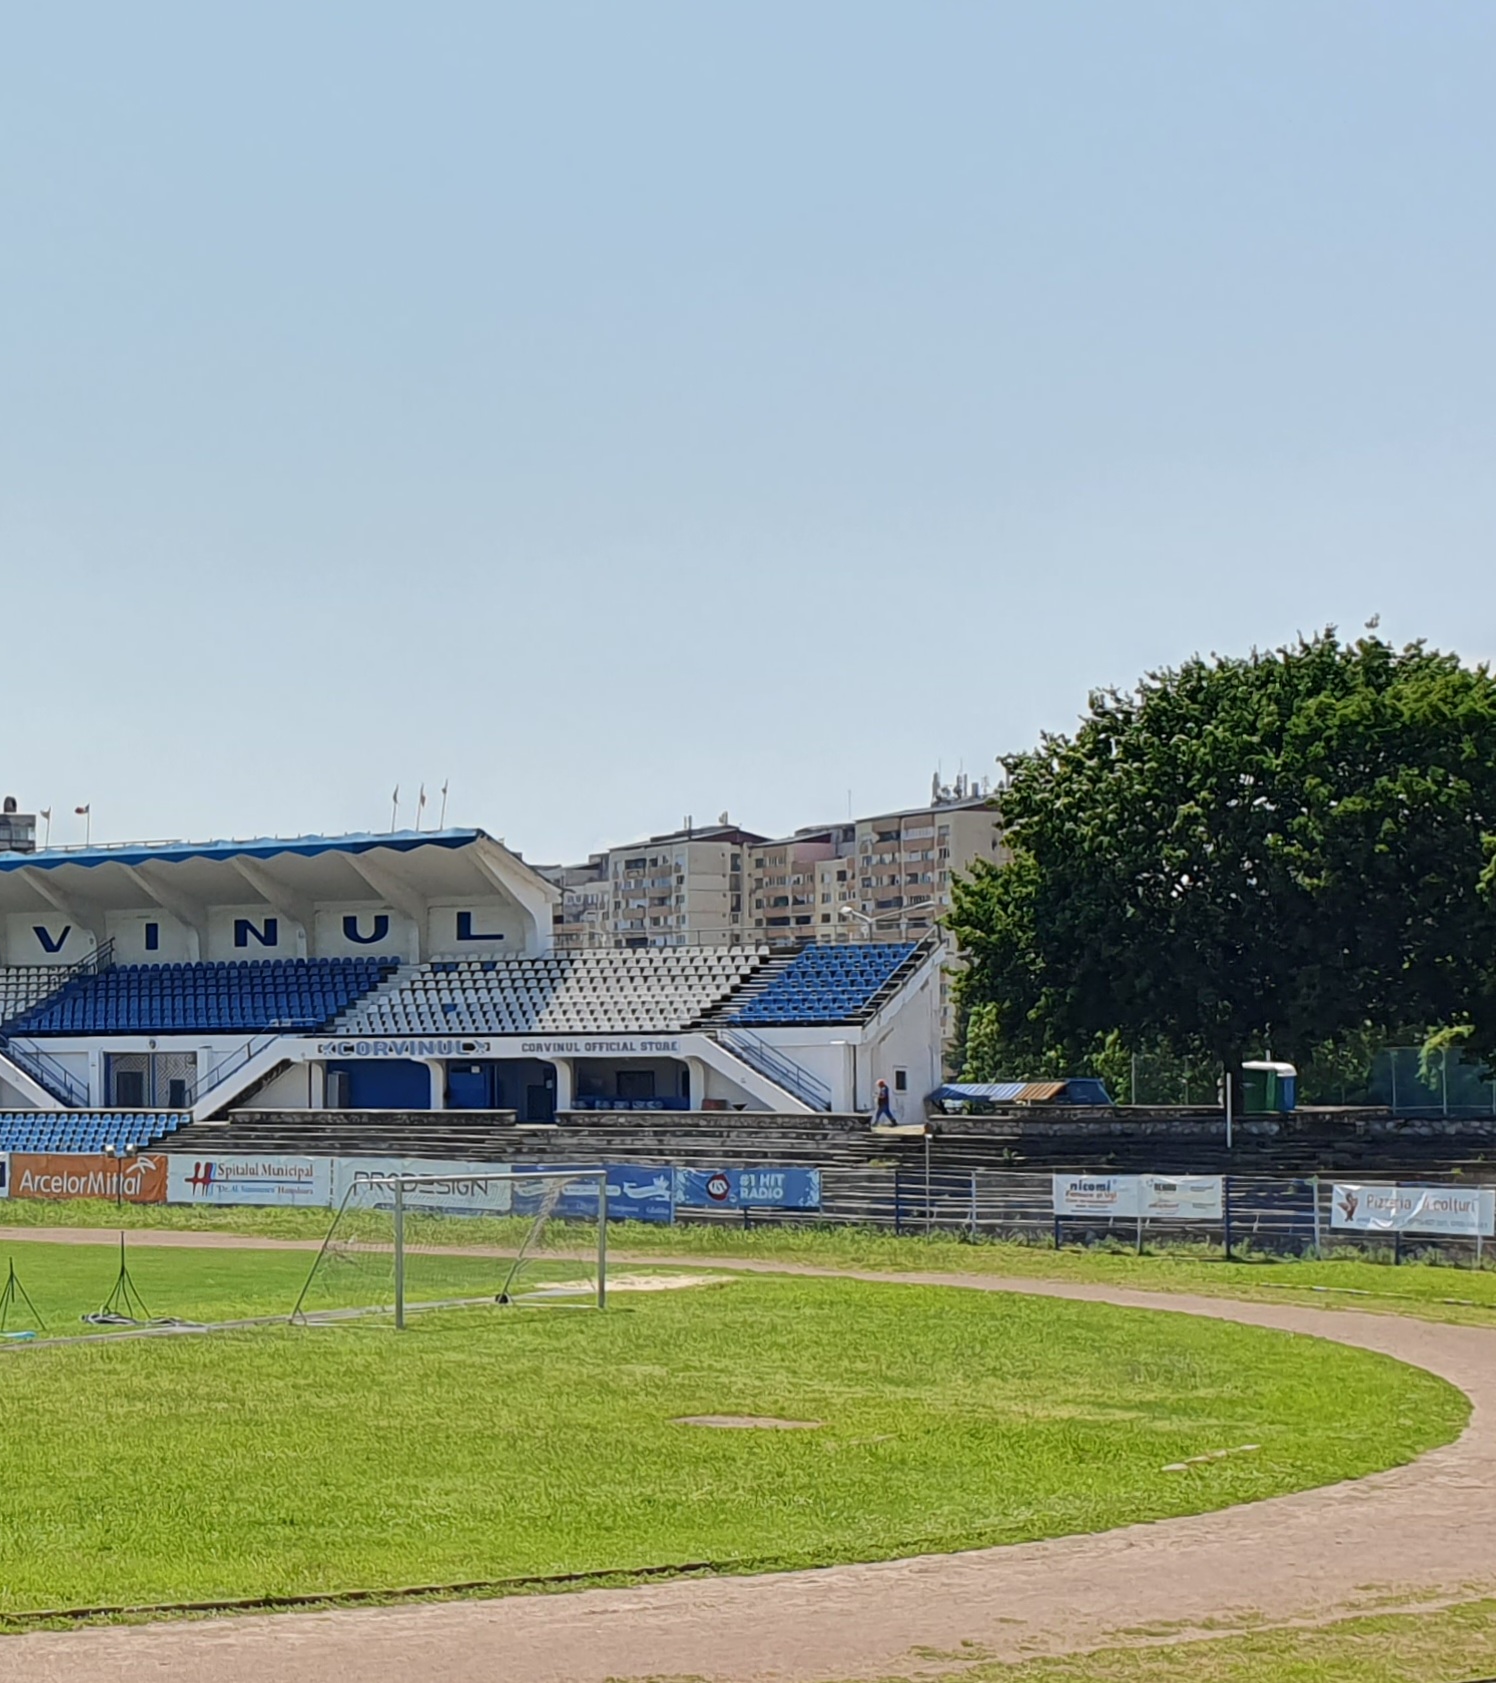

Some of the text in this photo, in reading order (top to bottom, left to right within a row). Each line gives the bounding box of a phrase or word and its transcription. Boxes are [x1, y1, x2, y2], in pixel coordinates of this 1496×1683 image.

[337, 1040, 471, 1057] CORVINUL
[521, 1041, 678, 1053] CORVINUL OFFICIAL STORE
[218, 1162, 314, 1181] Spitalul Municipal
[759, 1173, 785, 1187] HIT
[740, 1187, 784, 1200] RADIO
